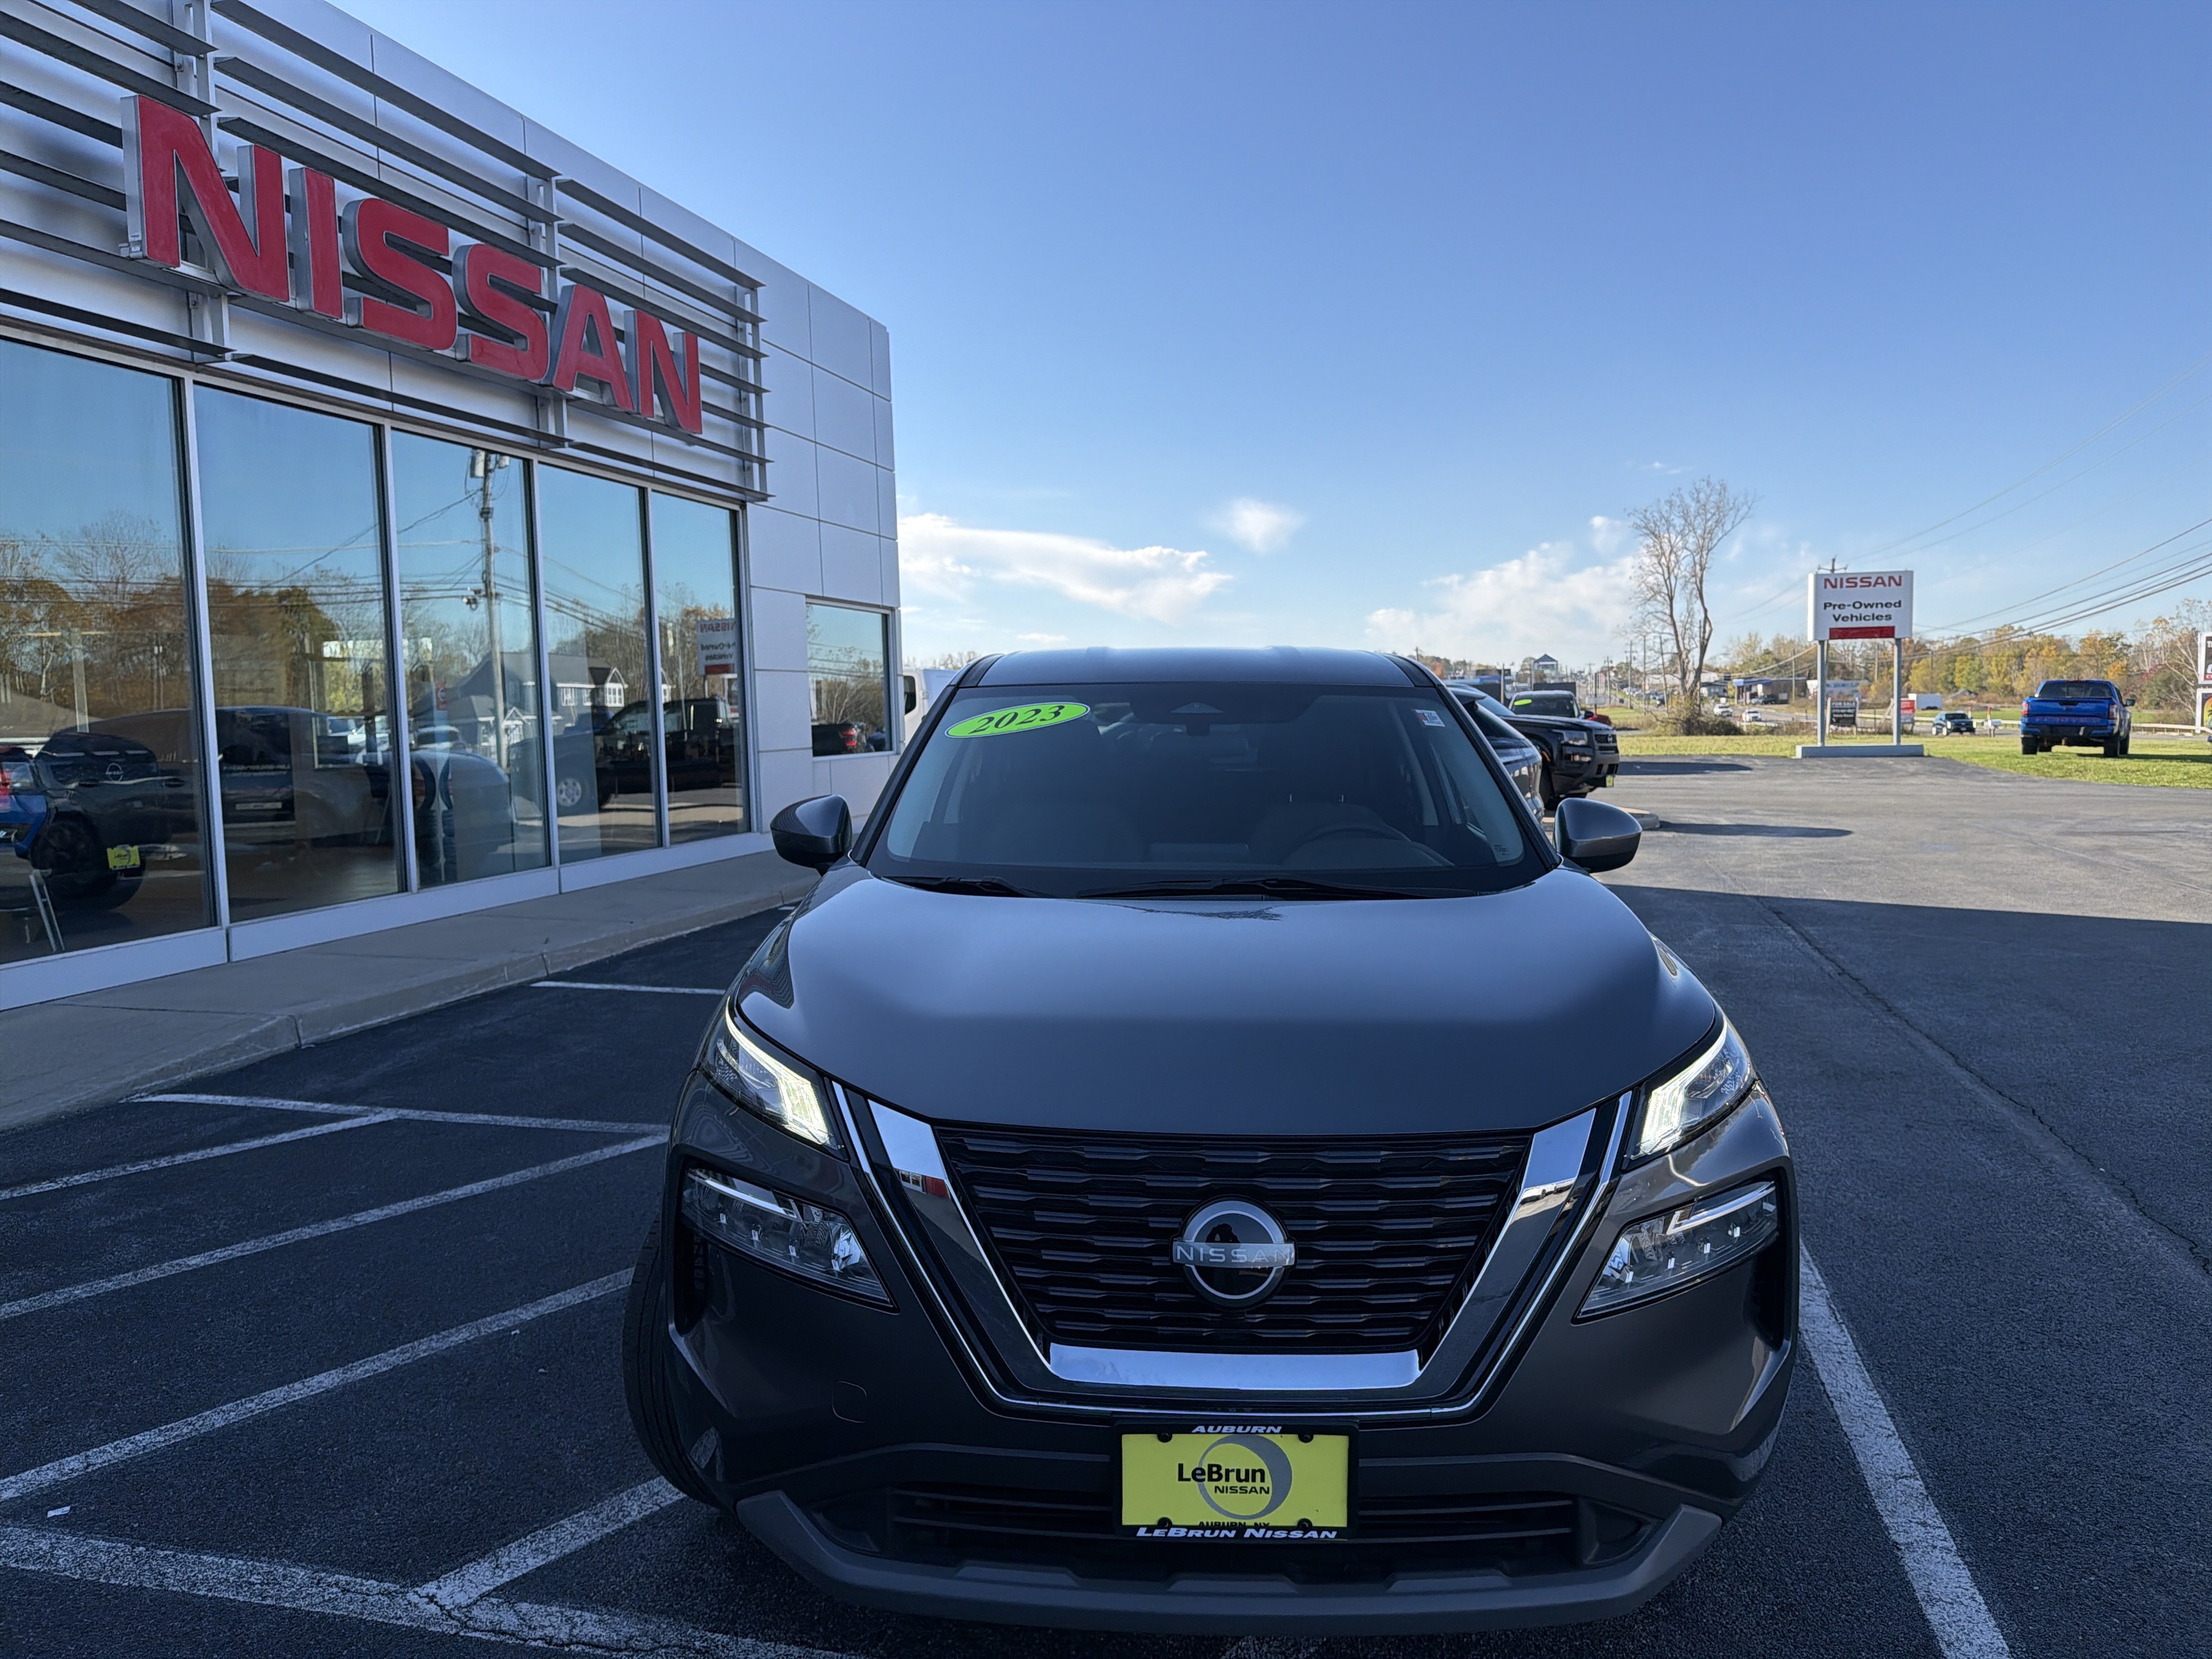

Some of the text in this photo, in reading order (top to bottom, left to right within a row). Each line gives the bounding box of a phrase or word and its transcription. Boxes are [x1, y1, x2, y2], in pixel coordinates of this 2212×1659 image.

[122, 94, 703, 435] NISSAN
[1824, 574, 1902, 589] NISSAN
[1823, 600, 1902, 610] Pre-Owned
[1832, 612, 1892, 622] Vehicles
[968, 705, 1065, 735] 2023
[1176, 1245, 1293, 1263] NISSAN
[1191, 1425, 1283, 1434] AUBURN
[1177, 1463, 1266, 1483] LeBrun
[1214, 1485, 1270, 1494] NISSAN
